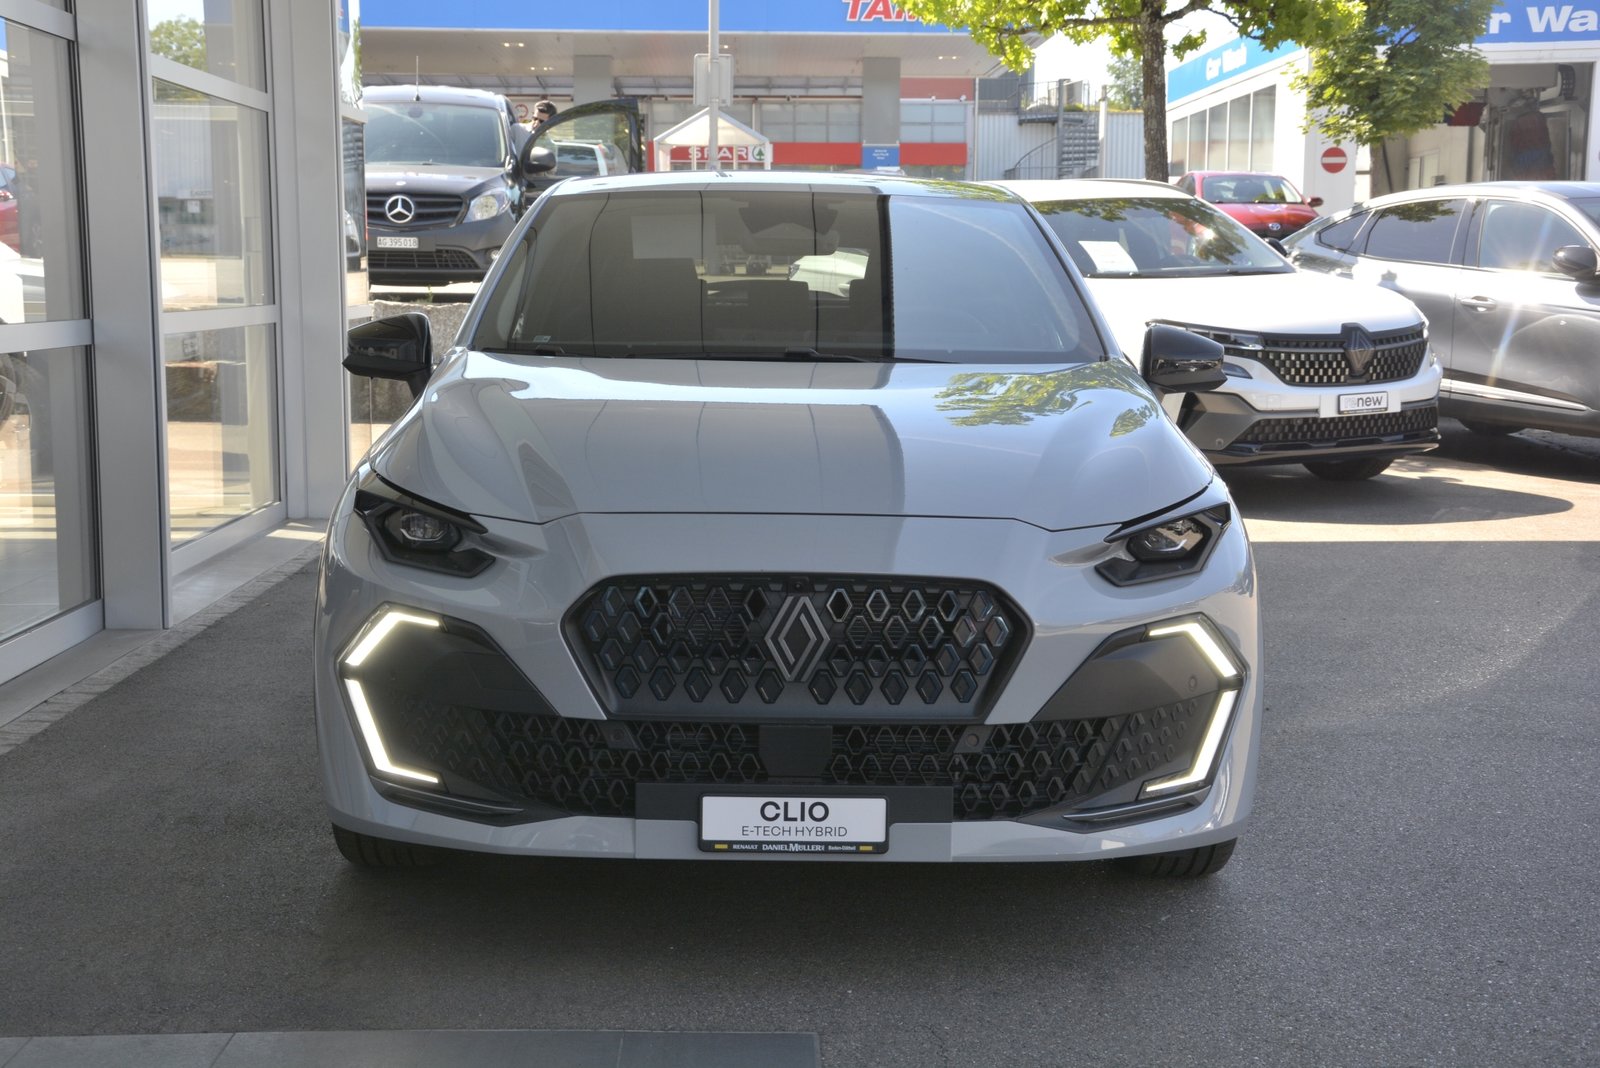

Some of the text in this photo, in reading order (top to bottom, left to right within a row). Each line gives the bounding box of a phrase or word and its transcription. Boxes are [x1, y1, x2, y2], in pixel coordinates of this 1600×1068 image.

[1526, 6, 1599, 33] Wa
[760, 801, 830, 822] CLIO
[741, 825, 848, 837] E-TECH HYBRID
